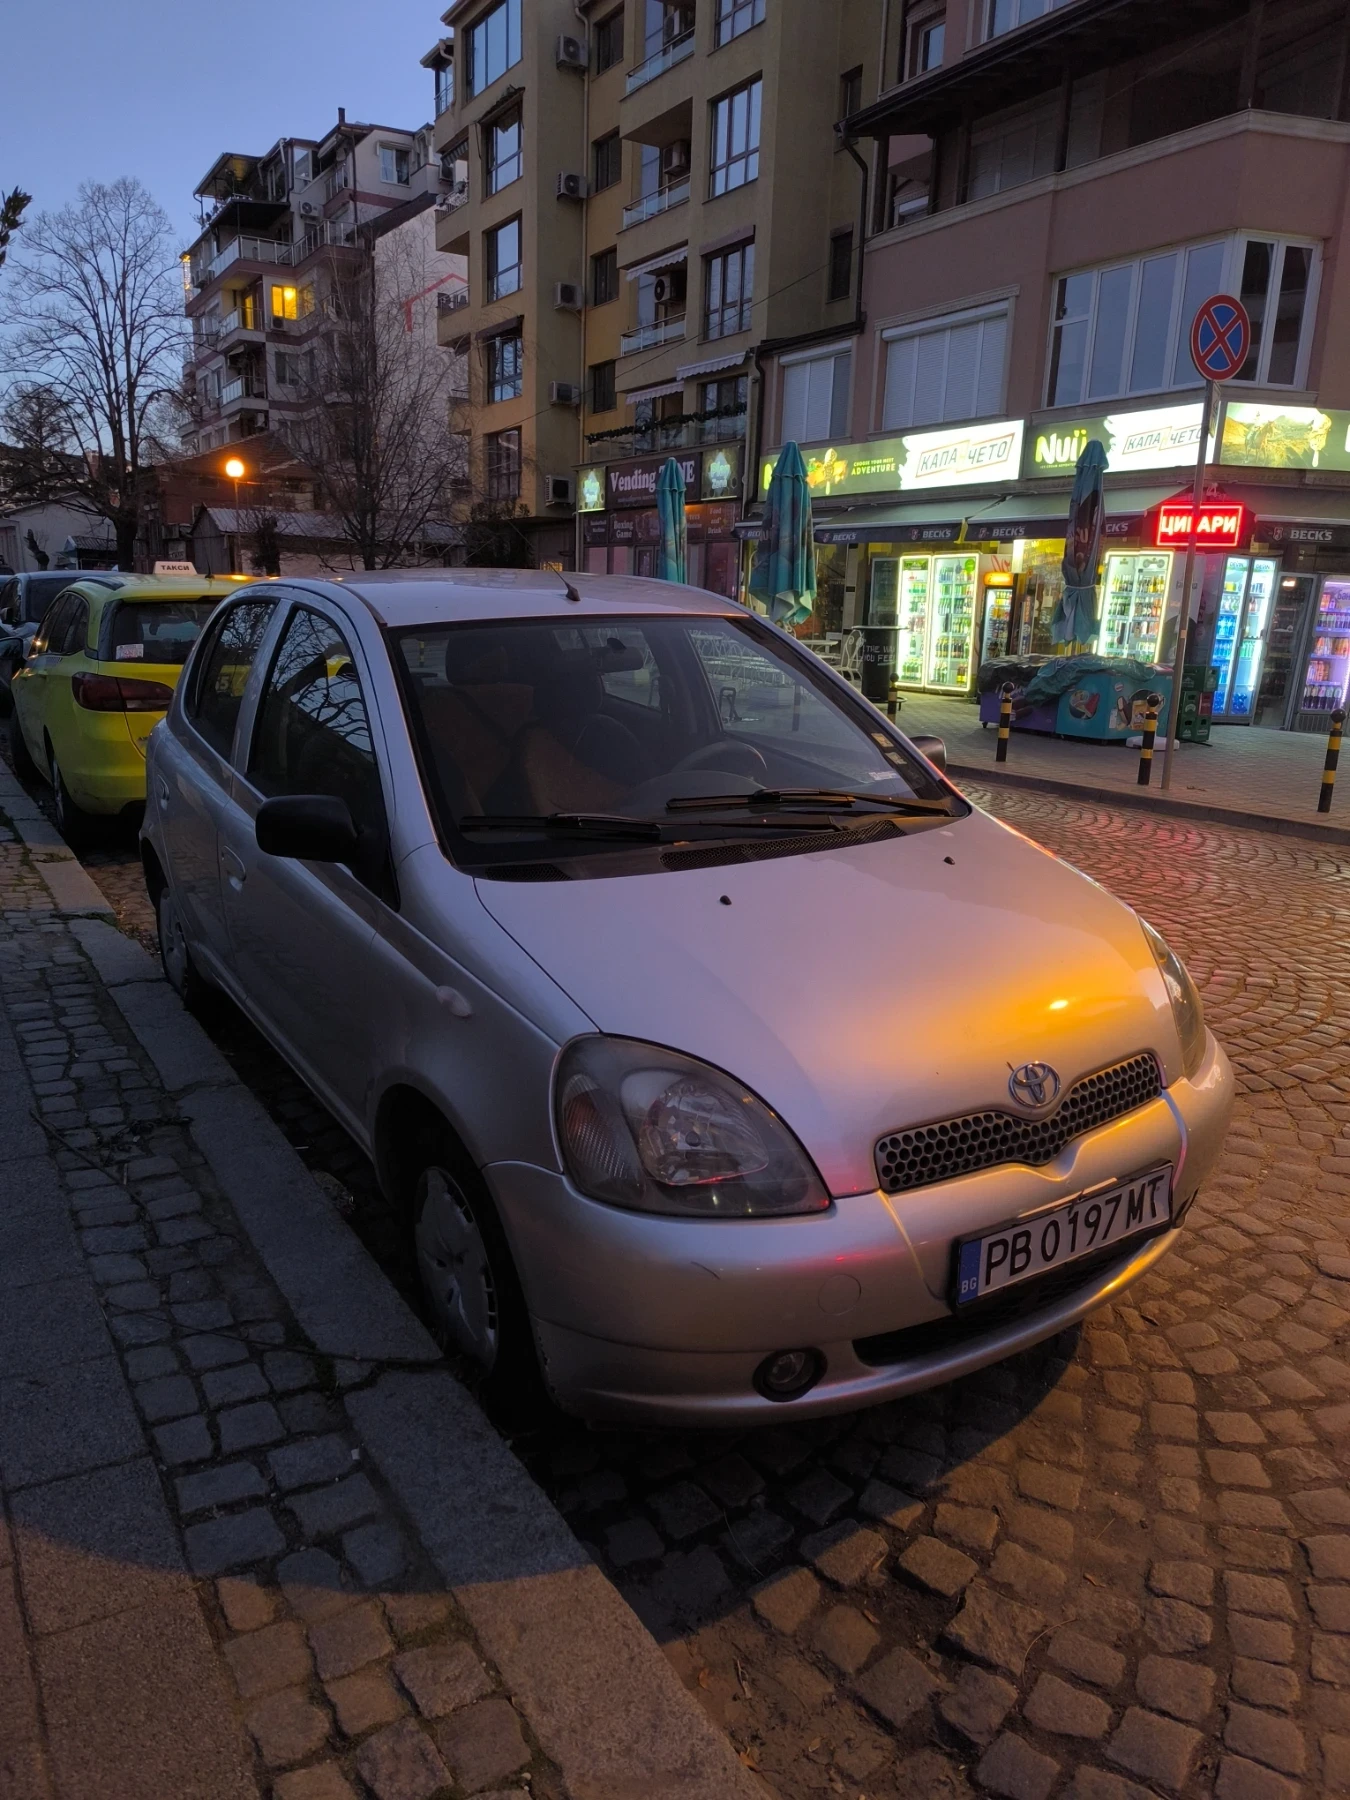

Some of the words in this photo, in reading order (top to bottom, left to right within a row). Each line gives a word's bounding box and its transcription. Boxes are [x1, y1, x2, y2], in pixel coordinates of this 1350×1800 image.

[851, 463, 896, 475] ADVENTURE
[610, 468, 656, 492] Vending
[659, 460, 695, 483] NE
[613, 520, 634, 530] Boxing
[1106, 522, 1129, 533] CK'S
[615, 530, 632, 539] Game
[921, 529, 951, 539] BECK'S
[992, 526, 1026, 538] BECK'S
[1290, 529, 1333, 541] BECK'S
[866, 645, 881, 654] THE
[985, 1229, 1032, 1287] PB
[1040, 1193, 1123, 1263] 0197
[1125, 1174, 1166, 1231] MT
[960, 1276, 978, 1294] BG
